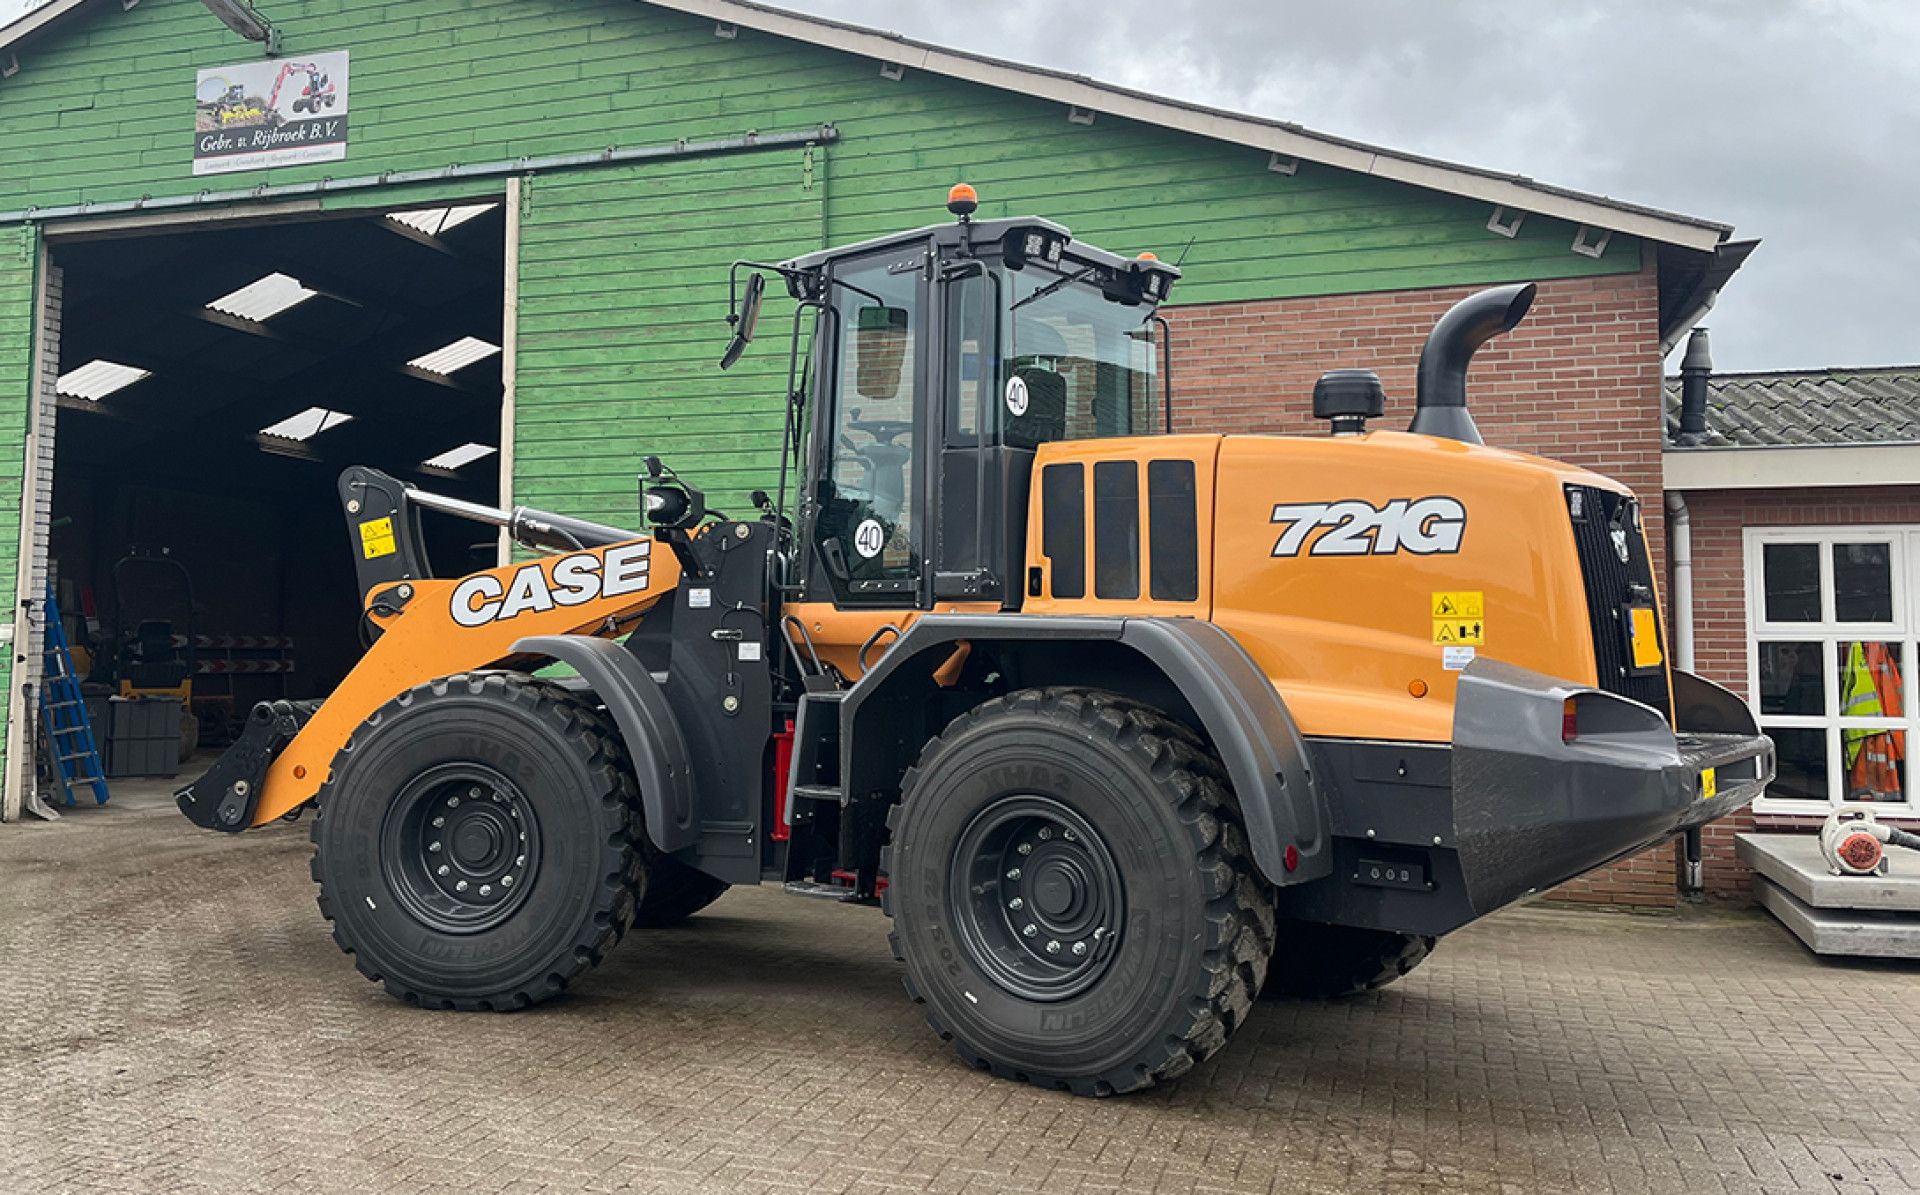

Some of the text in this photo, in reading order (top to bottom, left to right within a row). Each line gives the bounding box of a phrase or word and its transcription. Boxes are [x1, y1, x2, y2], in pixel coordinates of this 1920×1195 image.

[201, 134, 232, 152] Gebr.
[1008, 383, 1026, 410] 40
[859, 526, 881, 551] 40
[1270, 495, 1467, 557] 721G
[450, 539, 651, 627] CASE
